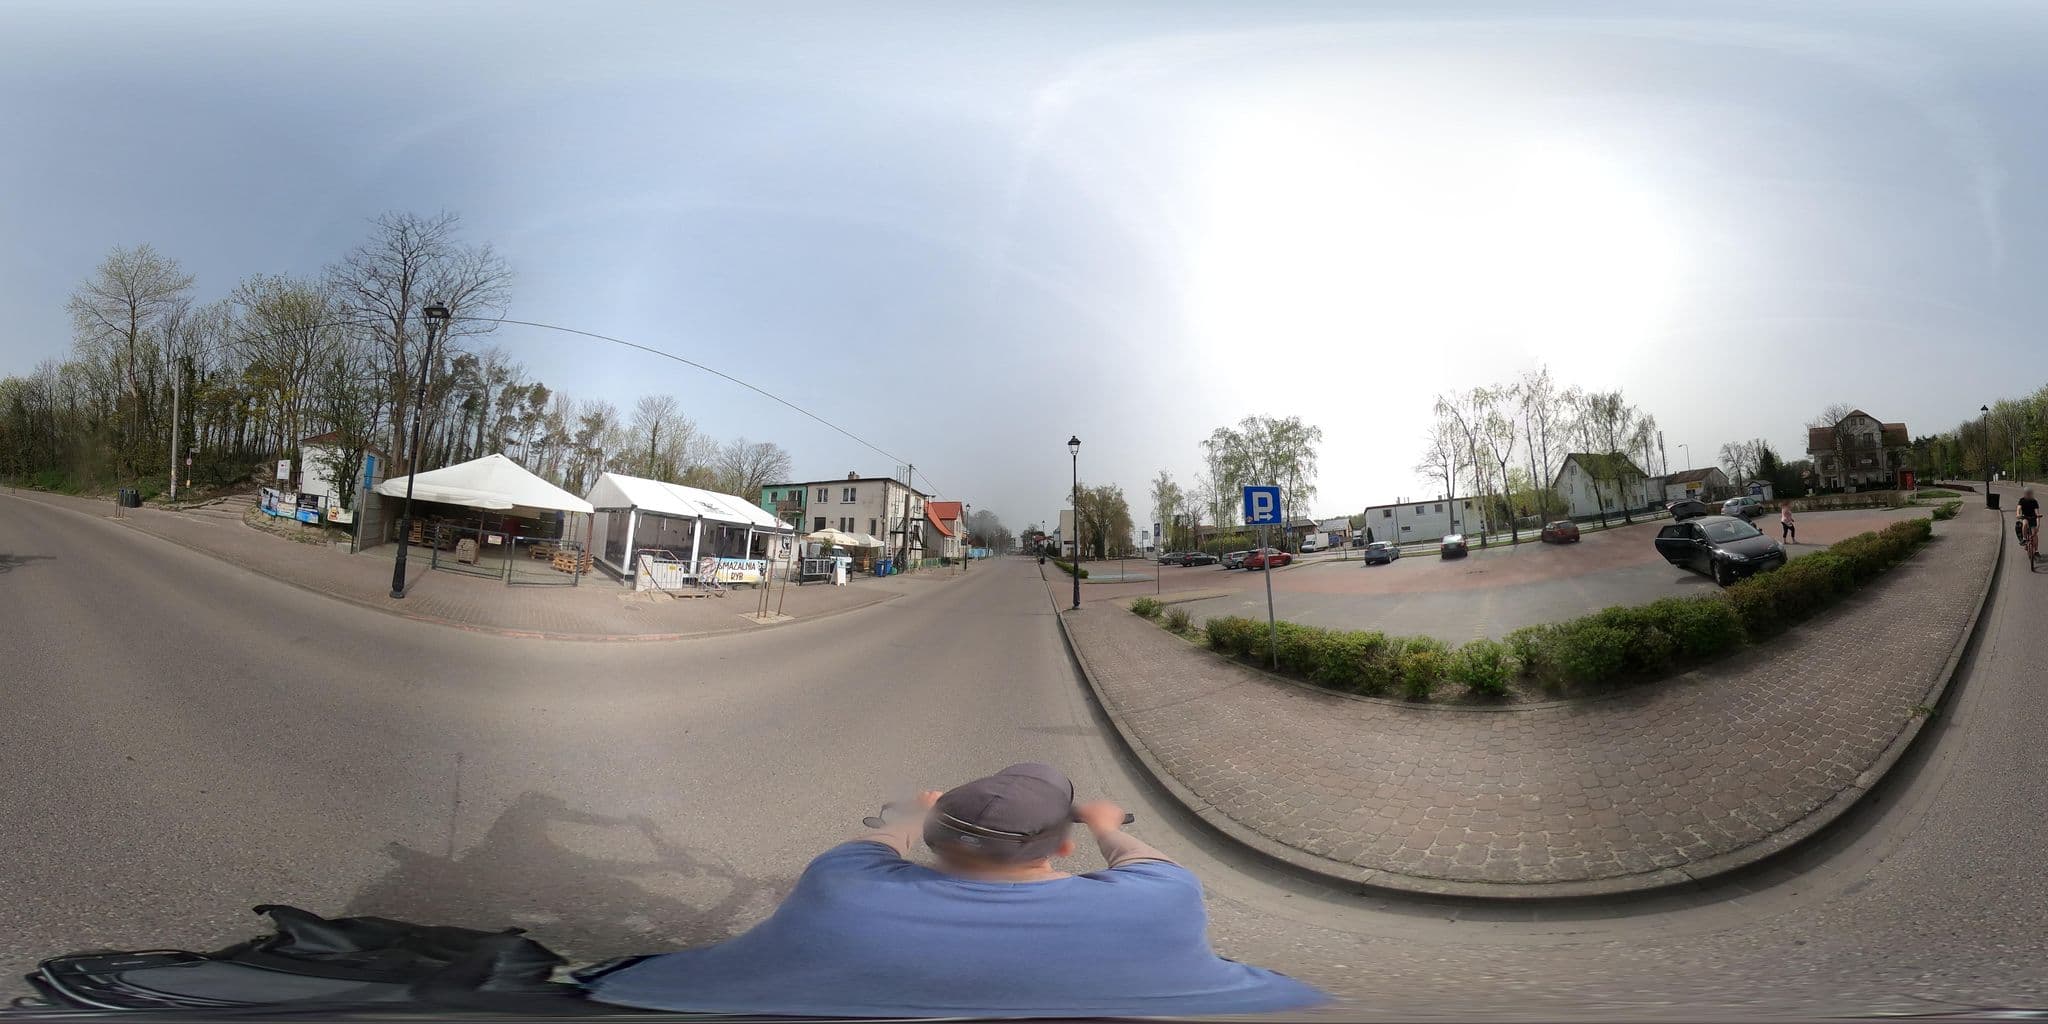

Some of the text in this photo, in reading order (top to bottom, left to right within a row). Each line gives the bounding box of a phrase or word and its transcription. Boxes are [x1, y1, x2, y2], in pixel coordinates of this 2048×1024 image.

[1252, 492, 1273, 521] P
[718, 561, 756, 570] SMAZALNIA
[730, 572, 744, 580] RYB
